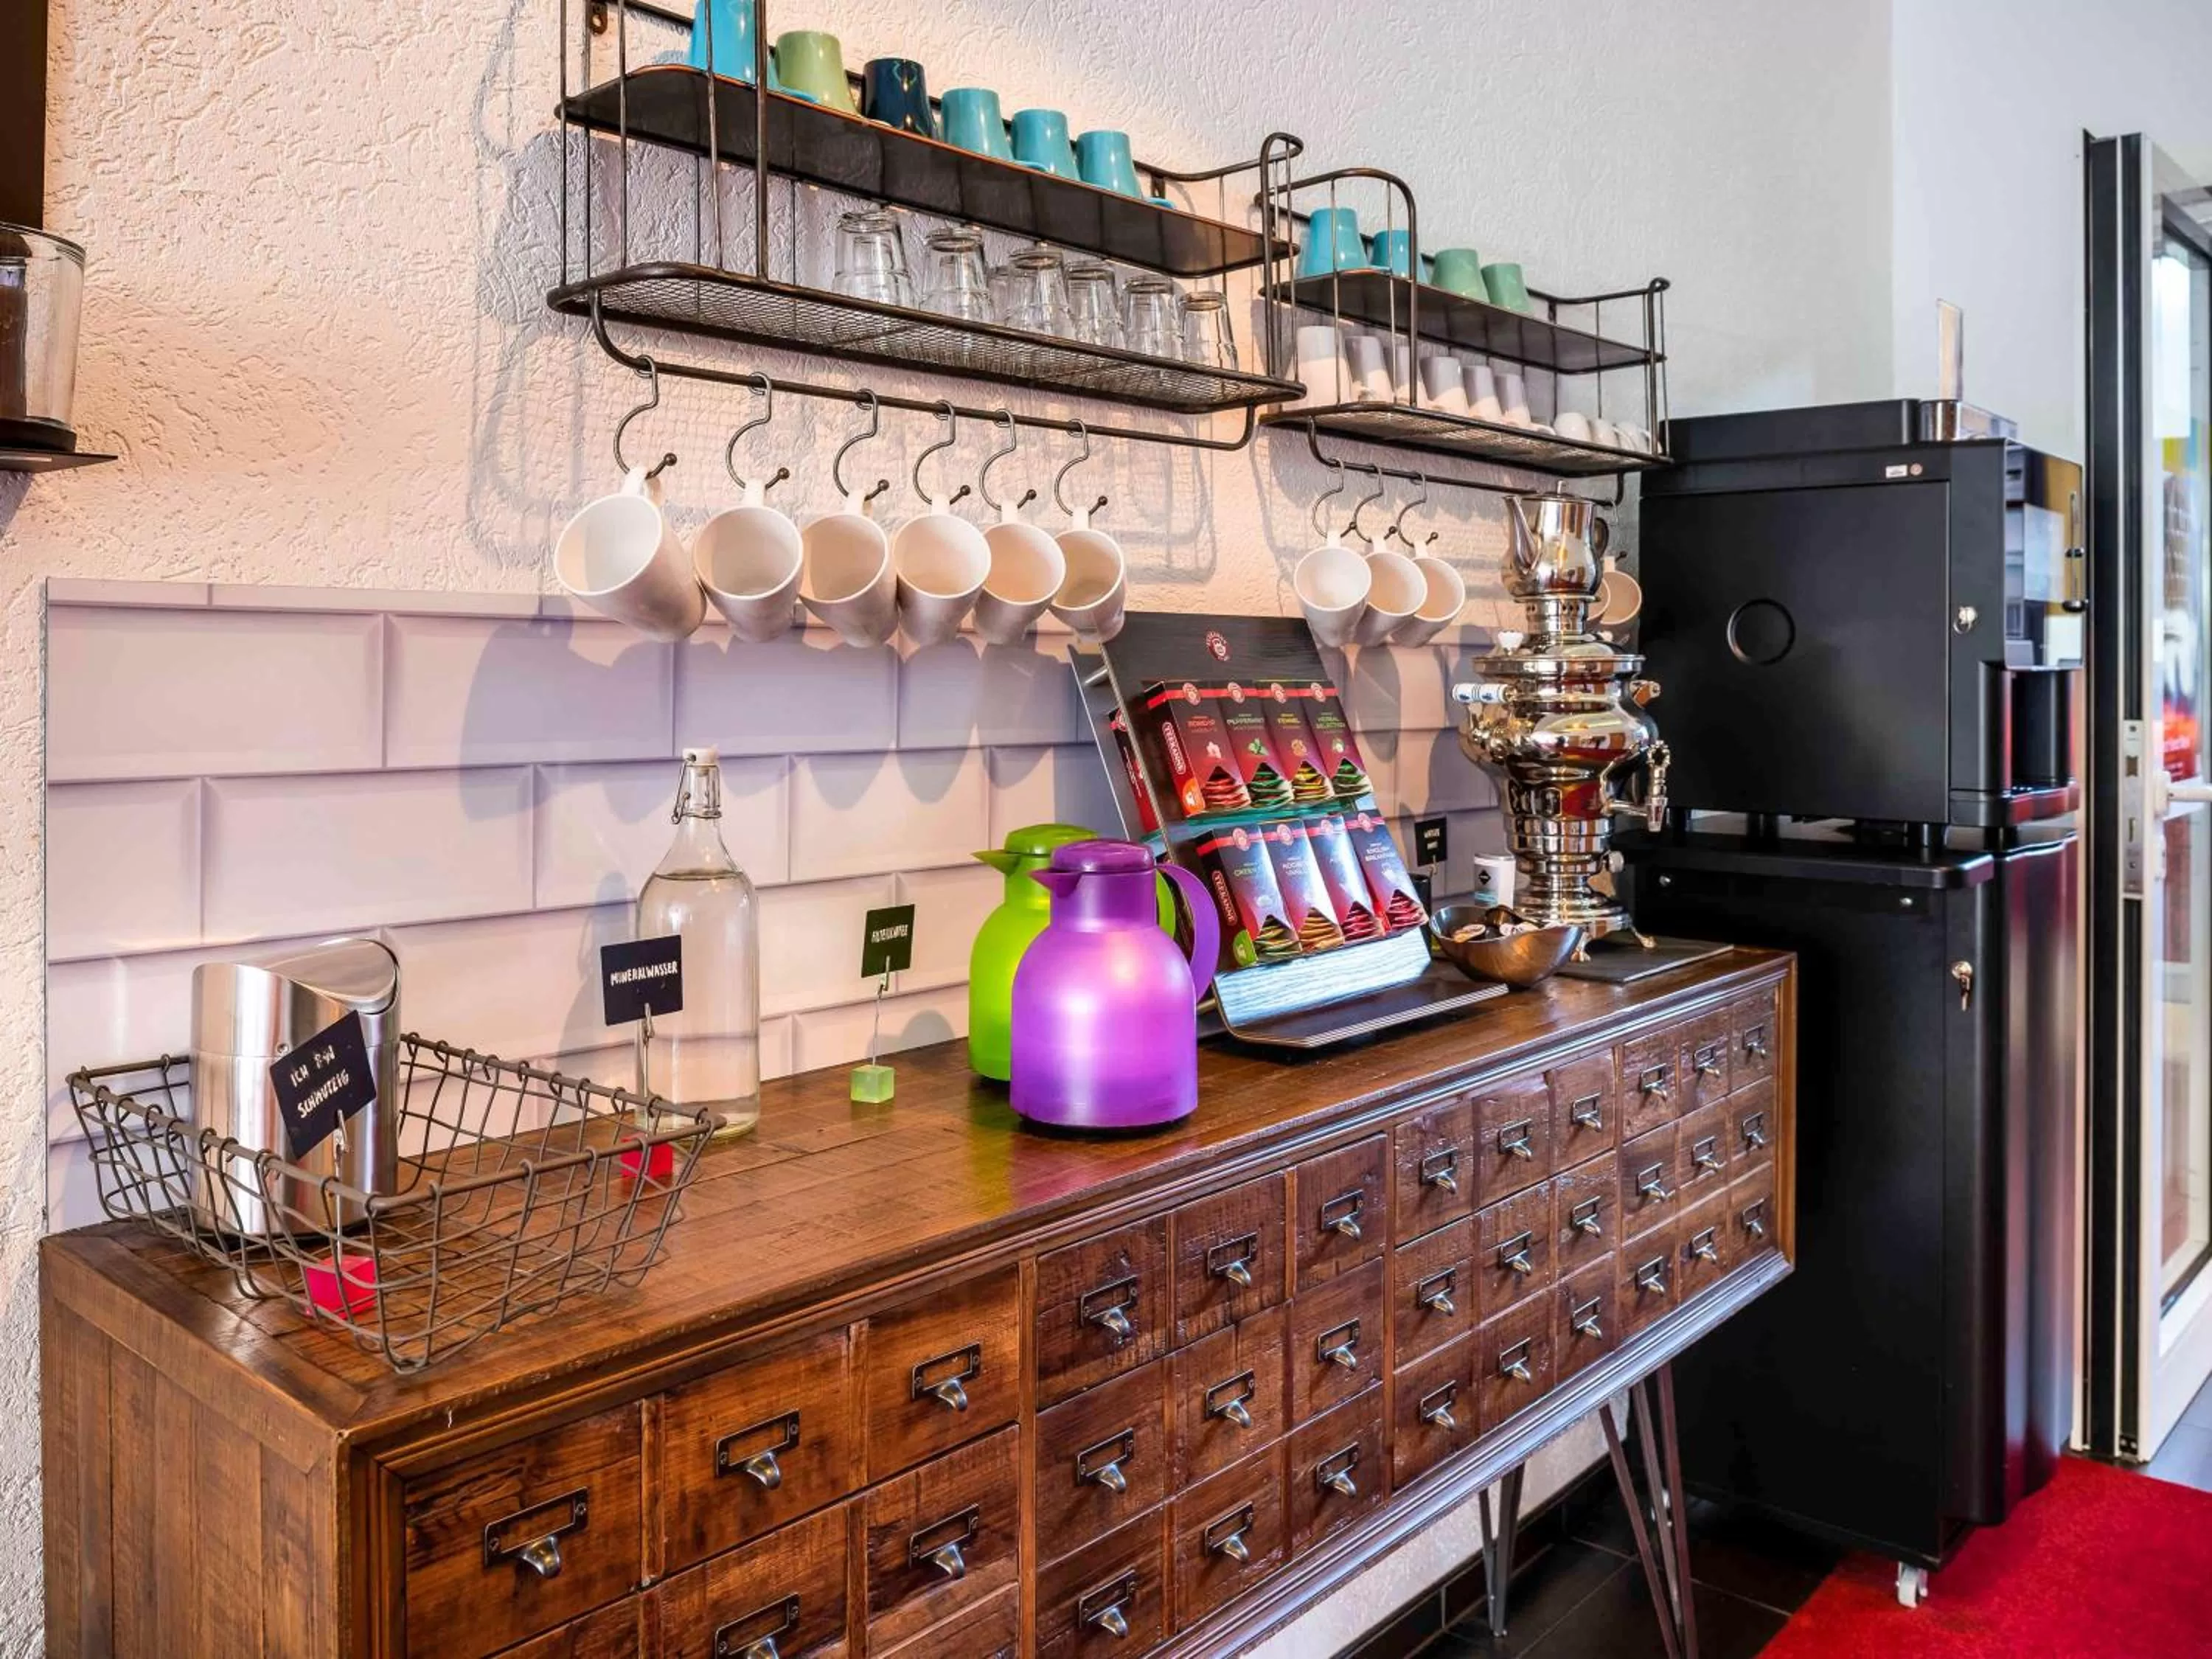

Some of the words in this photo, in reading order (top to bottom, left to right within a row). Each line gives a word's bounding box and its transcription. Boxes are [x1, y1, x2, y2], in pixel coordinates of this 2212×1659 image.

[610, 961, 678, 987] MINERALWASSER
[290, 1064, 310, 1088] ICH
[296, 1068, 350, 1119] SCHMUTZIG
